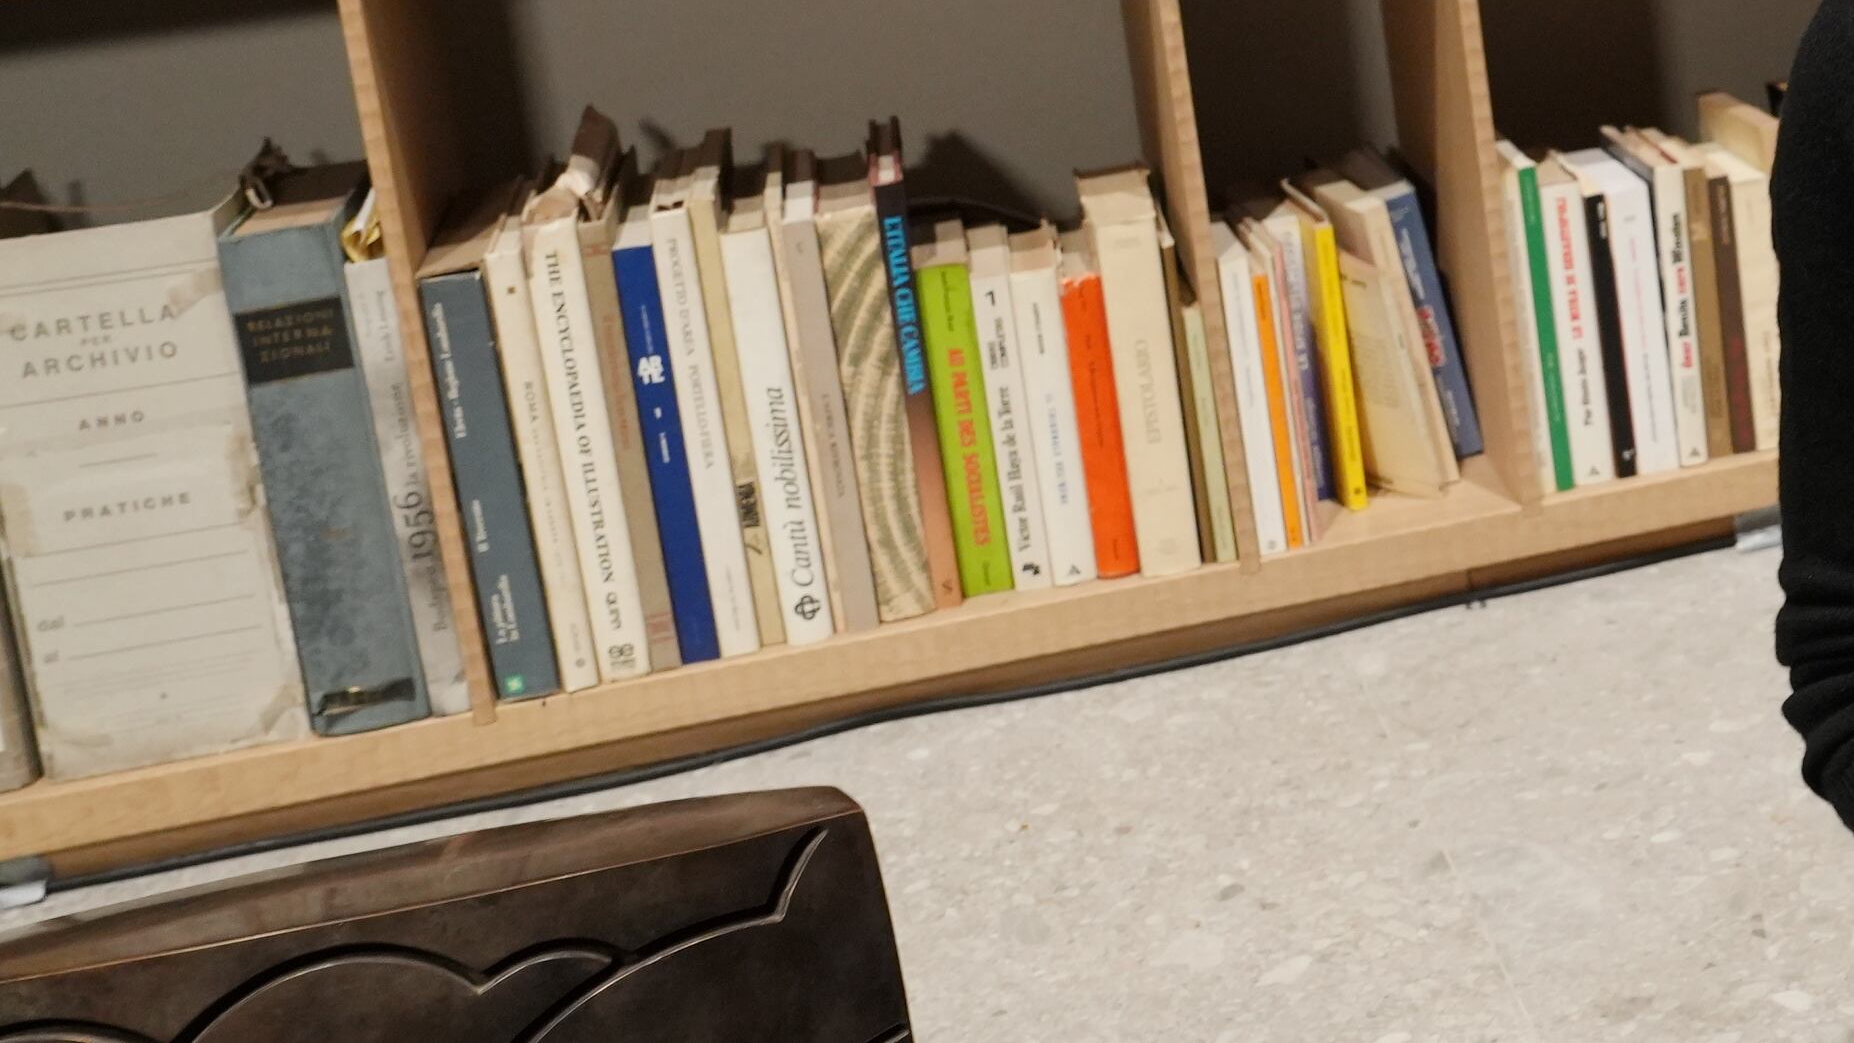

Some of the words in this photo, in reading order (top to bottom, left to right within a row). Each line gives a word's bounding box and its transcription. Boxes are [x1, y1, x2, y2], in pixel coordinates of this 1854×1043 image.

[545, 250, 562, 287] THE
[884, 215, 909, 287] L'ITALIA
[665, 237, 687, 306] PROGETTO
[9, 304, 178, 341] CARTELLA
[247, 307, 335, 331] RELAZIONI
[894, 285, 915, 324] CHE
[22, 341, 178, 379] ARCHIVIO
[553, 290, 583, 431] ENCYCLOPAEDIA
[900, 324, 925, 395] CAMBIA
[521, 379, 540, 424] ROMA
[950, 370, 971, 416] PARTI
[995, 385, 1011, 416] Torre
[1135, 337, 1160, 445] EPISTOLARIO
[78, 410, 145, 431] ANNO
[957, 418, 975, 448] DES
[999, 417, 1015, 430] la
[1002, 432, 1016, 447] de
[576, 434, 591, 459] OF
[764, 383, 800, 512] nobilissima
[1005, 448, 1022, 481] Haya
[63, 491, 192, 522] PRATICHE
[963, 452, 989, 547] SOCIALISTES
[396, 488, 436, 562] 1956
[582, 460, 612, 584] ILLUSTRATION
[1014, 516, 1032, 552] Victor
[783, 517, 813, 588] Cantù
